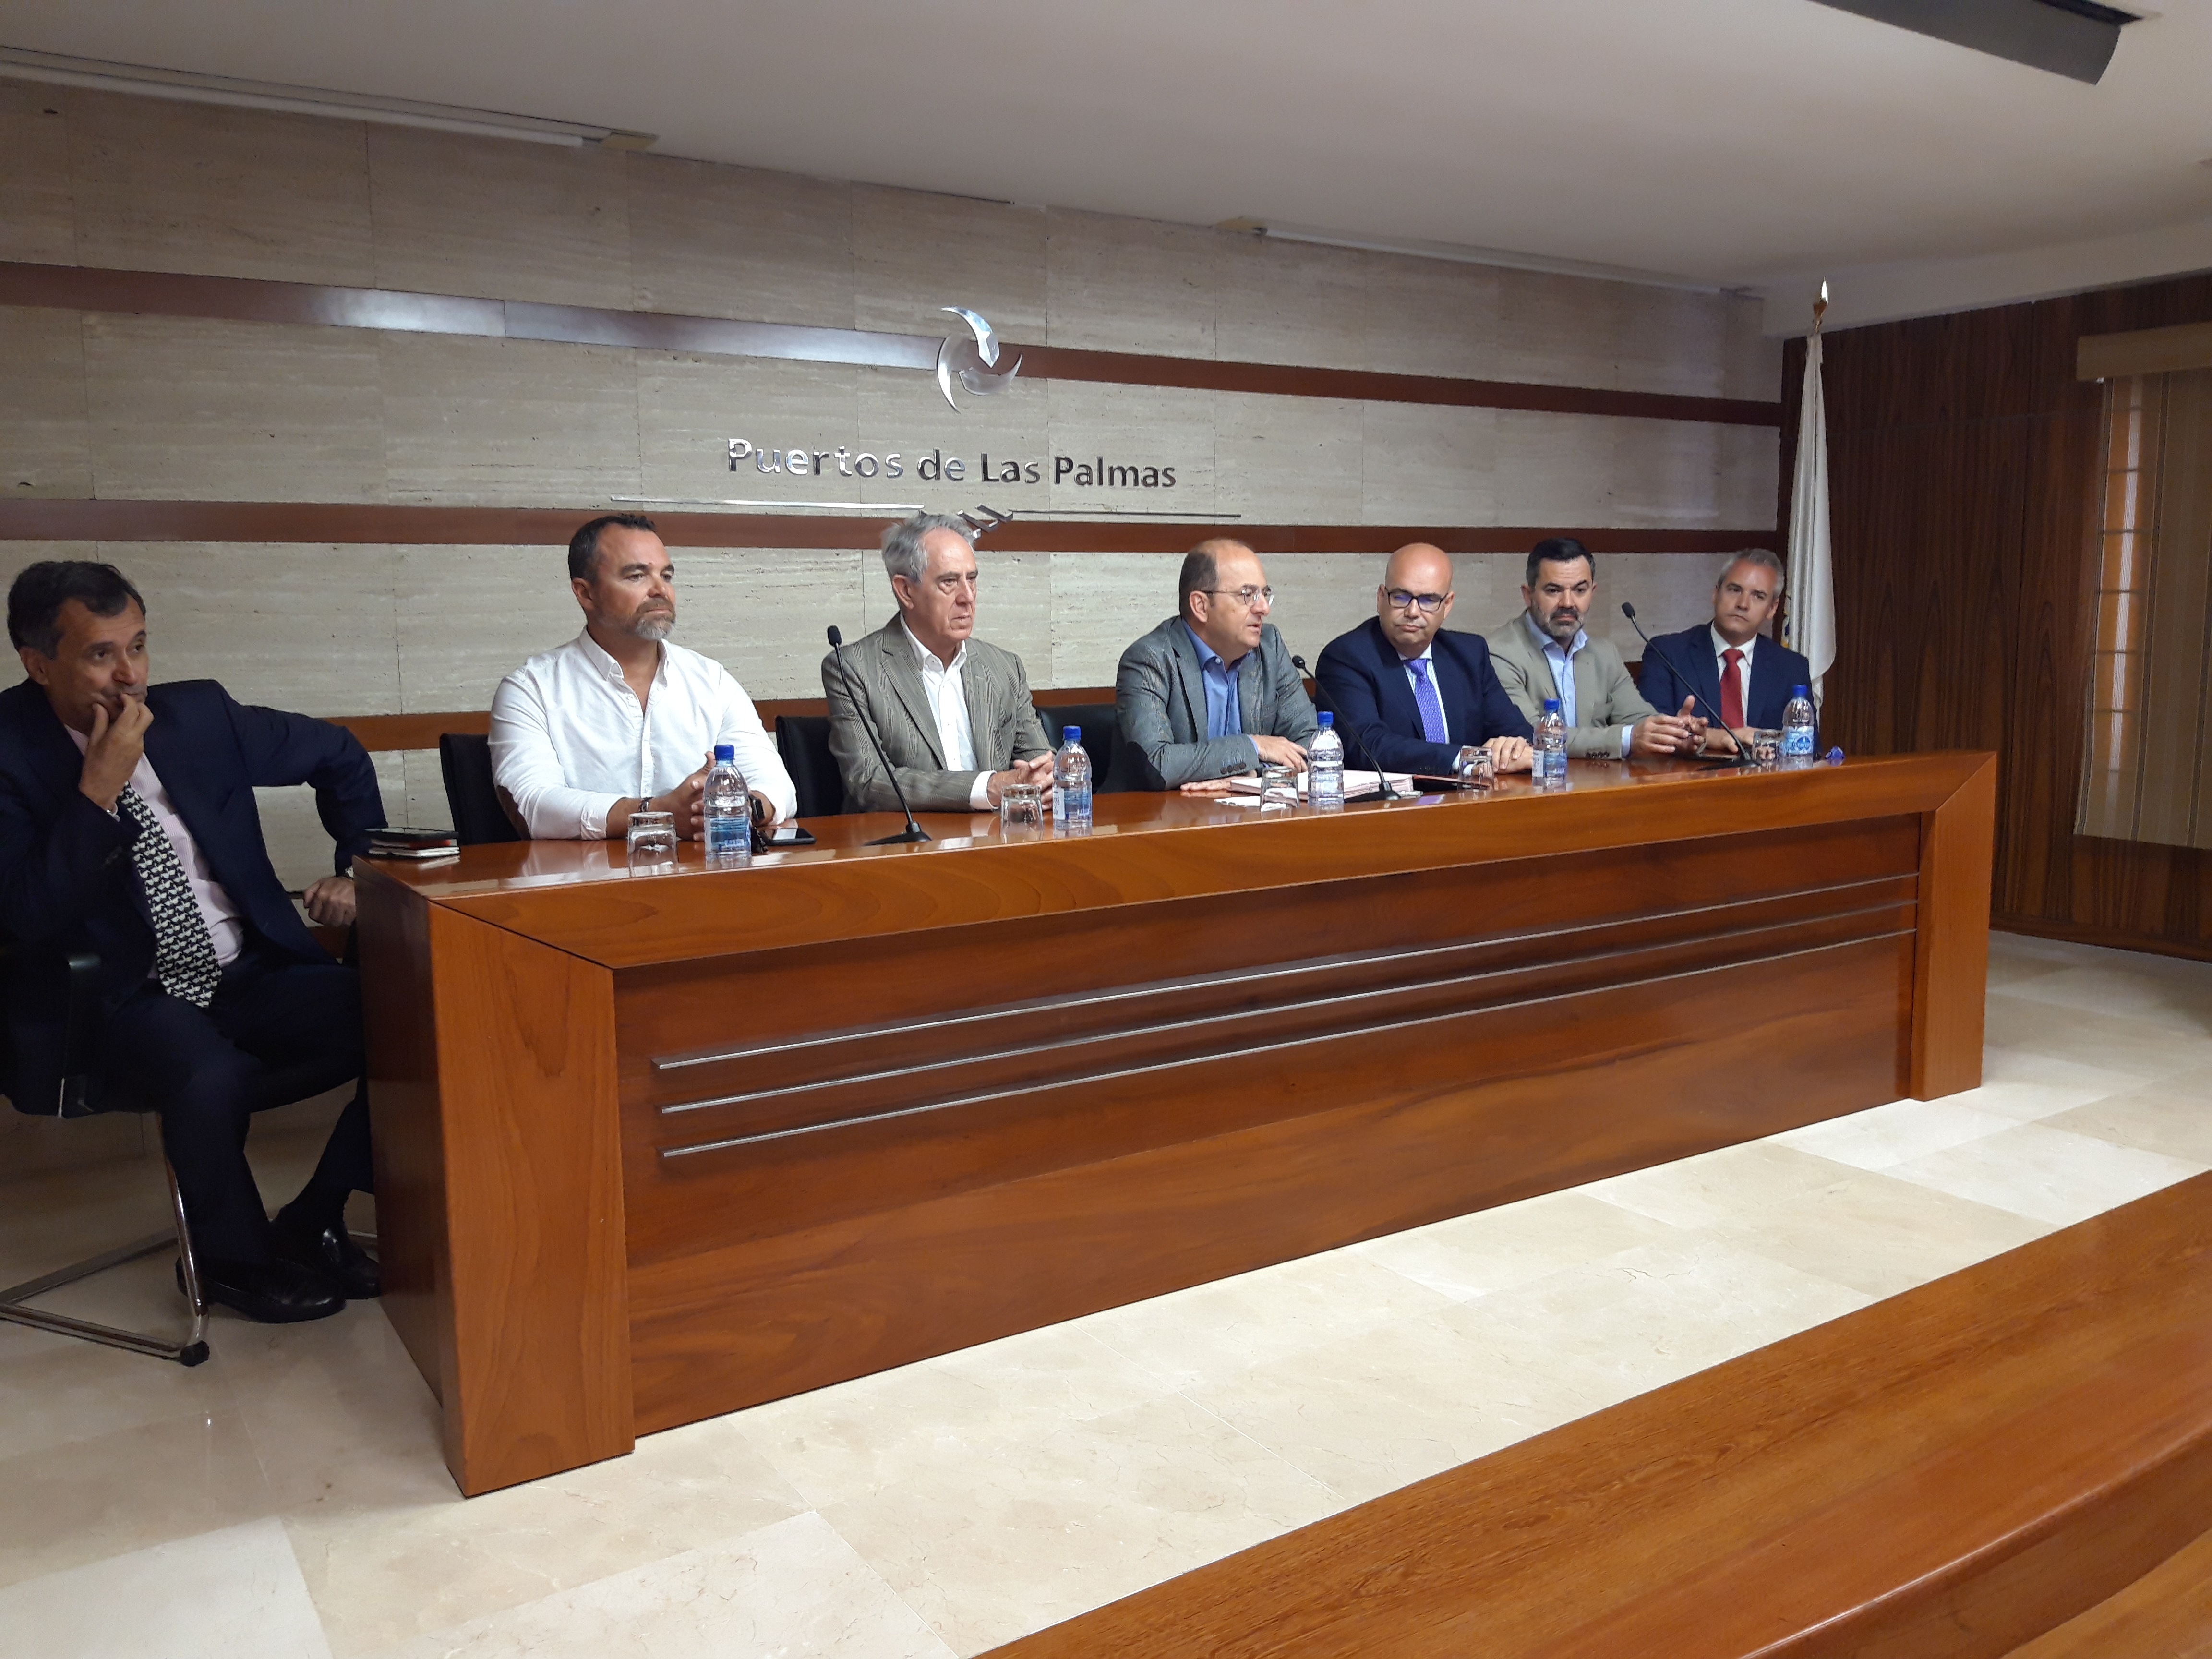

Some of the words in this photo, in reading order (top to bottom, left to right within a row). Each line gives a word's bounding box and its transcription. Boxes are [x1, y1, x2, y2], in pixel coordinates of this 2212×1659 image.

[728, 438, 903, 477] Puertos
[917, 447, 966, 481] de
[981, 452, 1041, 484] Las
[1054, 455, 1176, 488] Palmas
